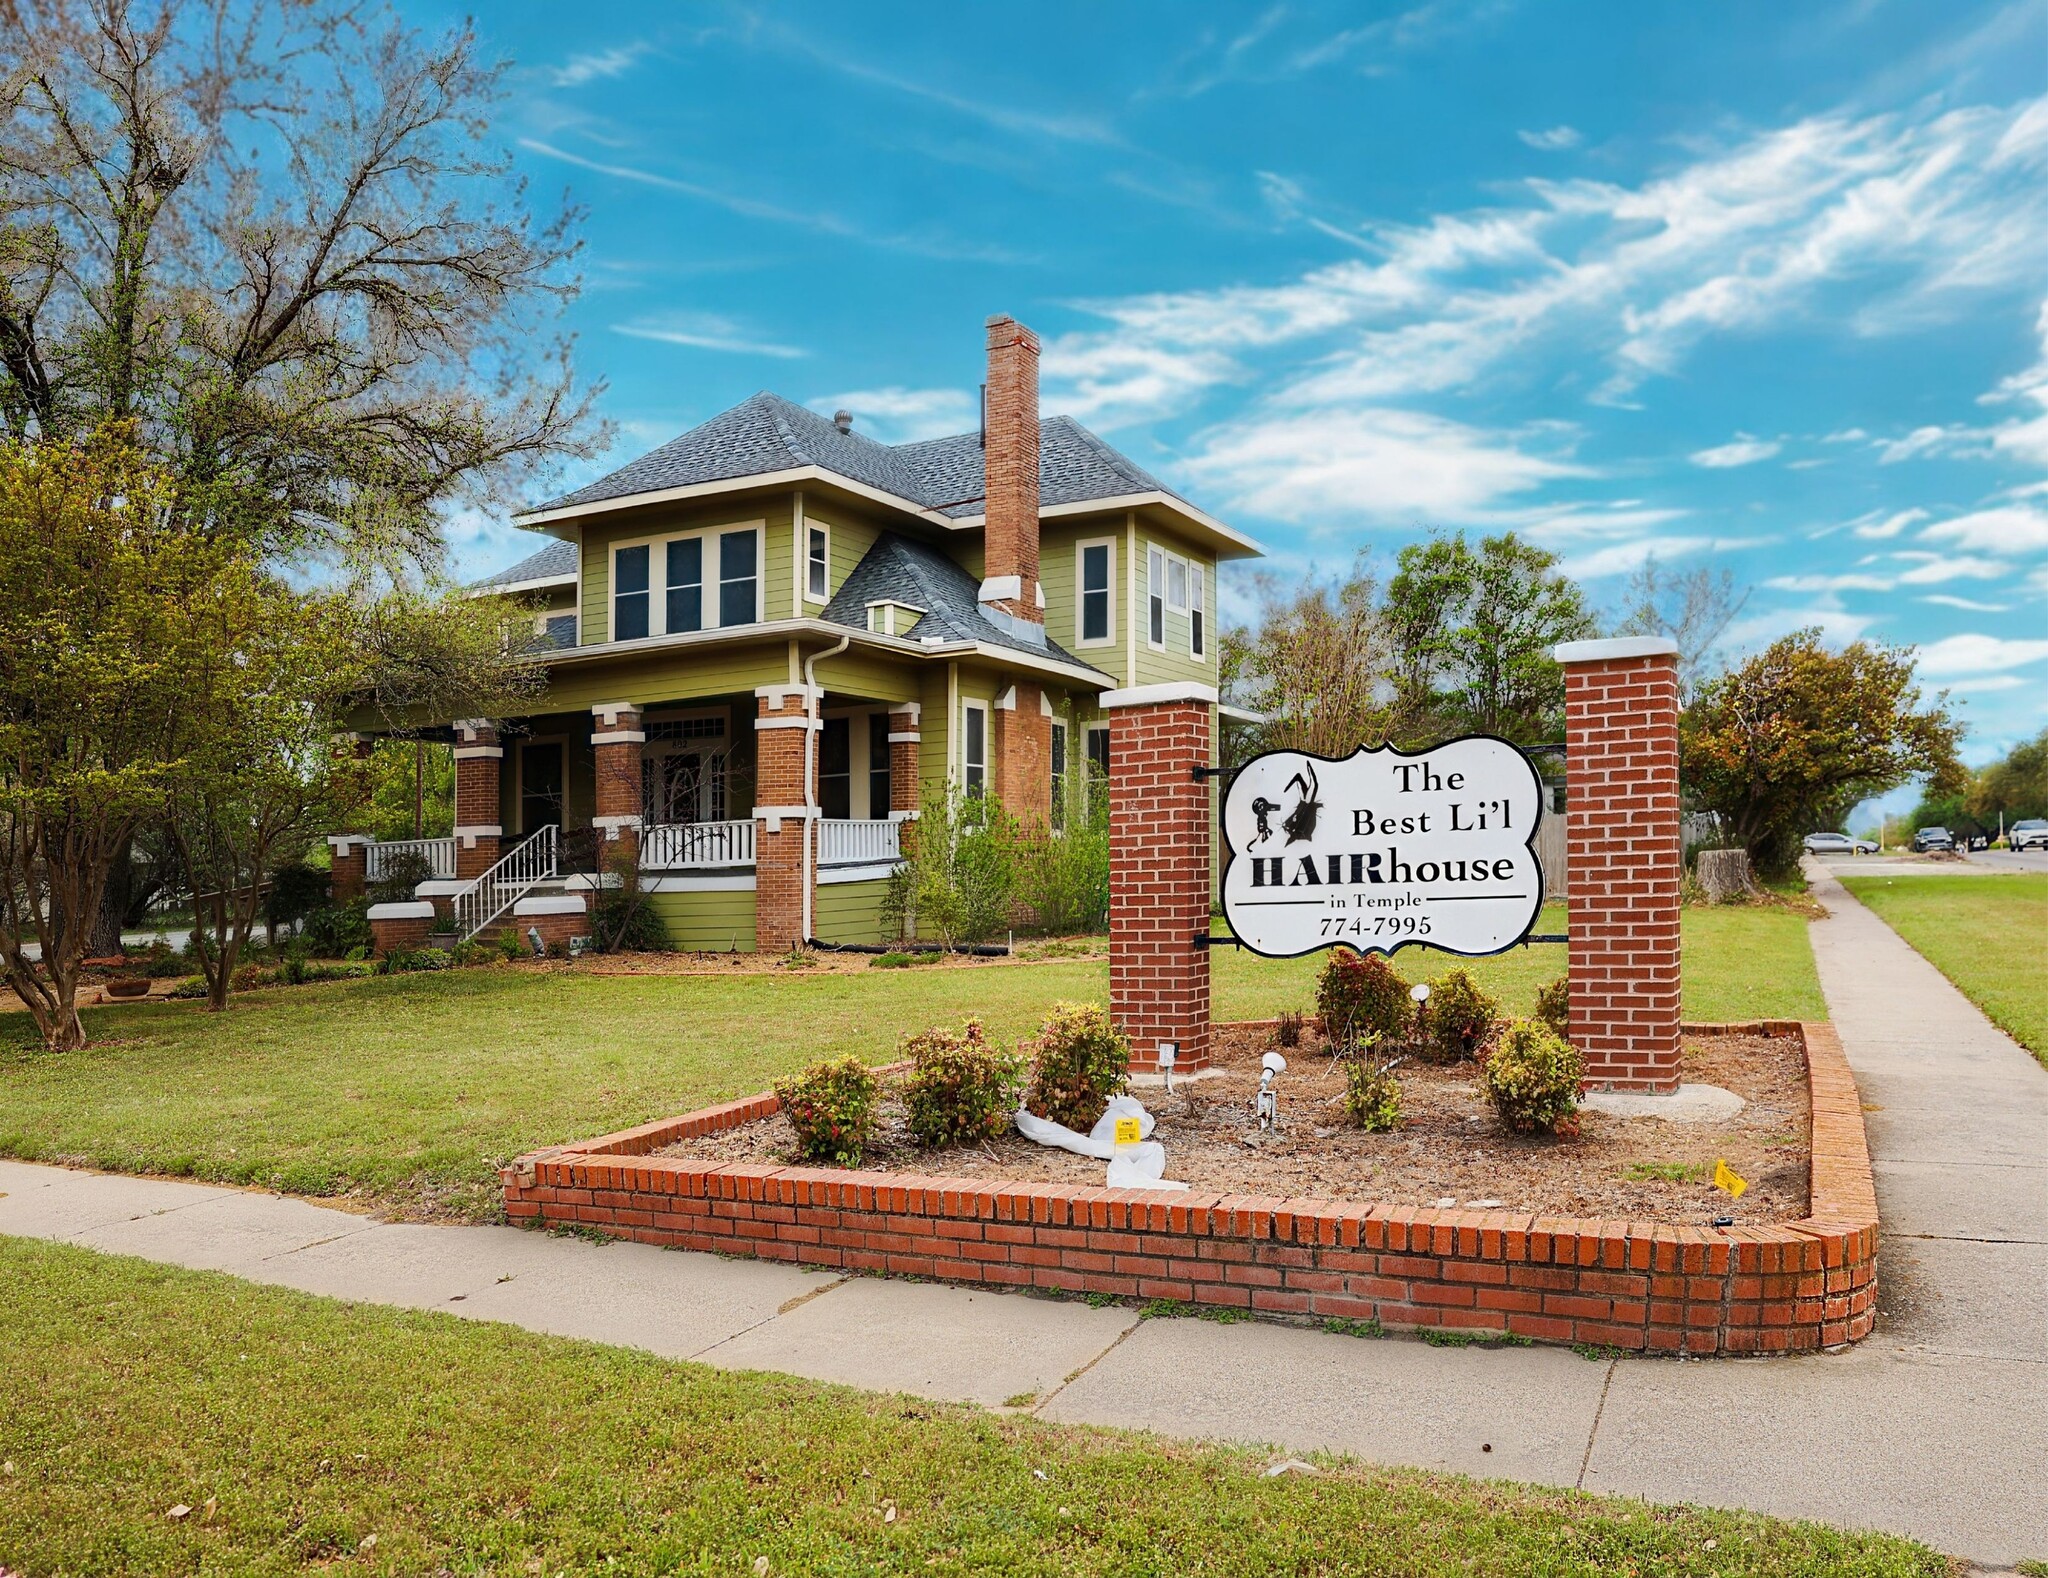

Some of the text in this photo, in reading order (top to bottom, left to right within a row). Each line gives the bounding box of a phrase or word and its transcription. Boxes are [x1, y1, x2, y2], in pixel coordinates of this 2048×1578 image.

[1392, 761, 1465, 794] The
[1351, 809, 1432, 836] Best
[1249, 847, 1515, 888] HAIRhouse
[1330, 892, 1422, 911] in Temple
[1320, 916, 1432, 937] 774-7995
